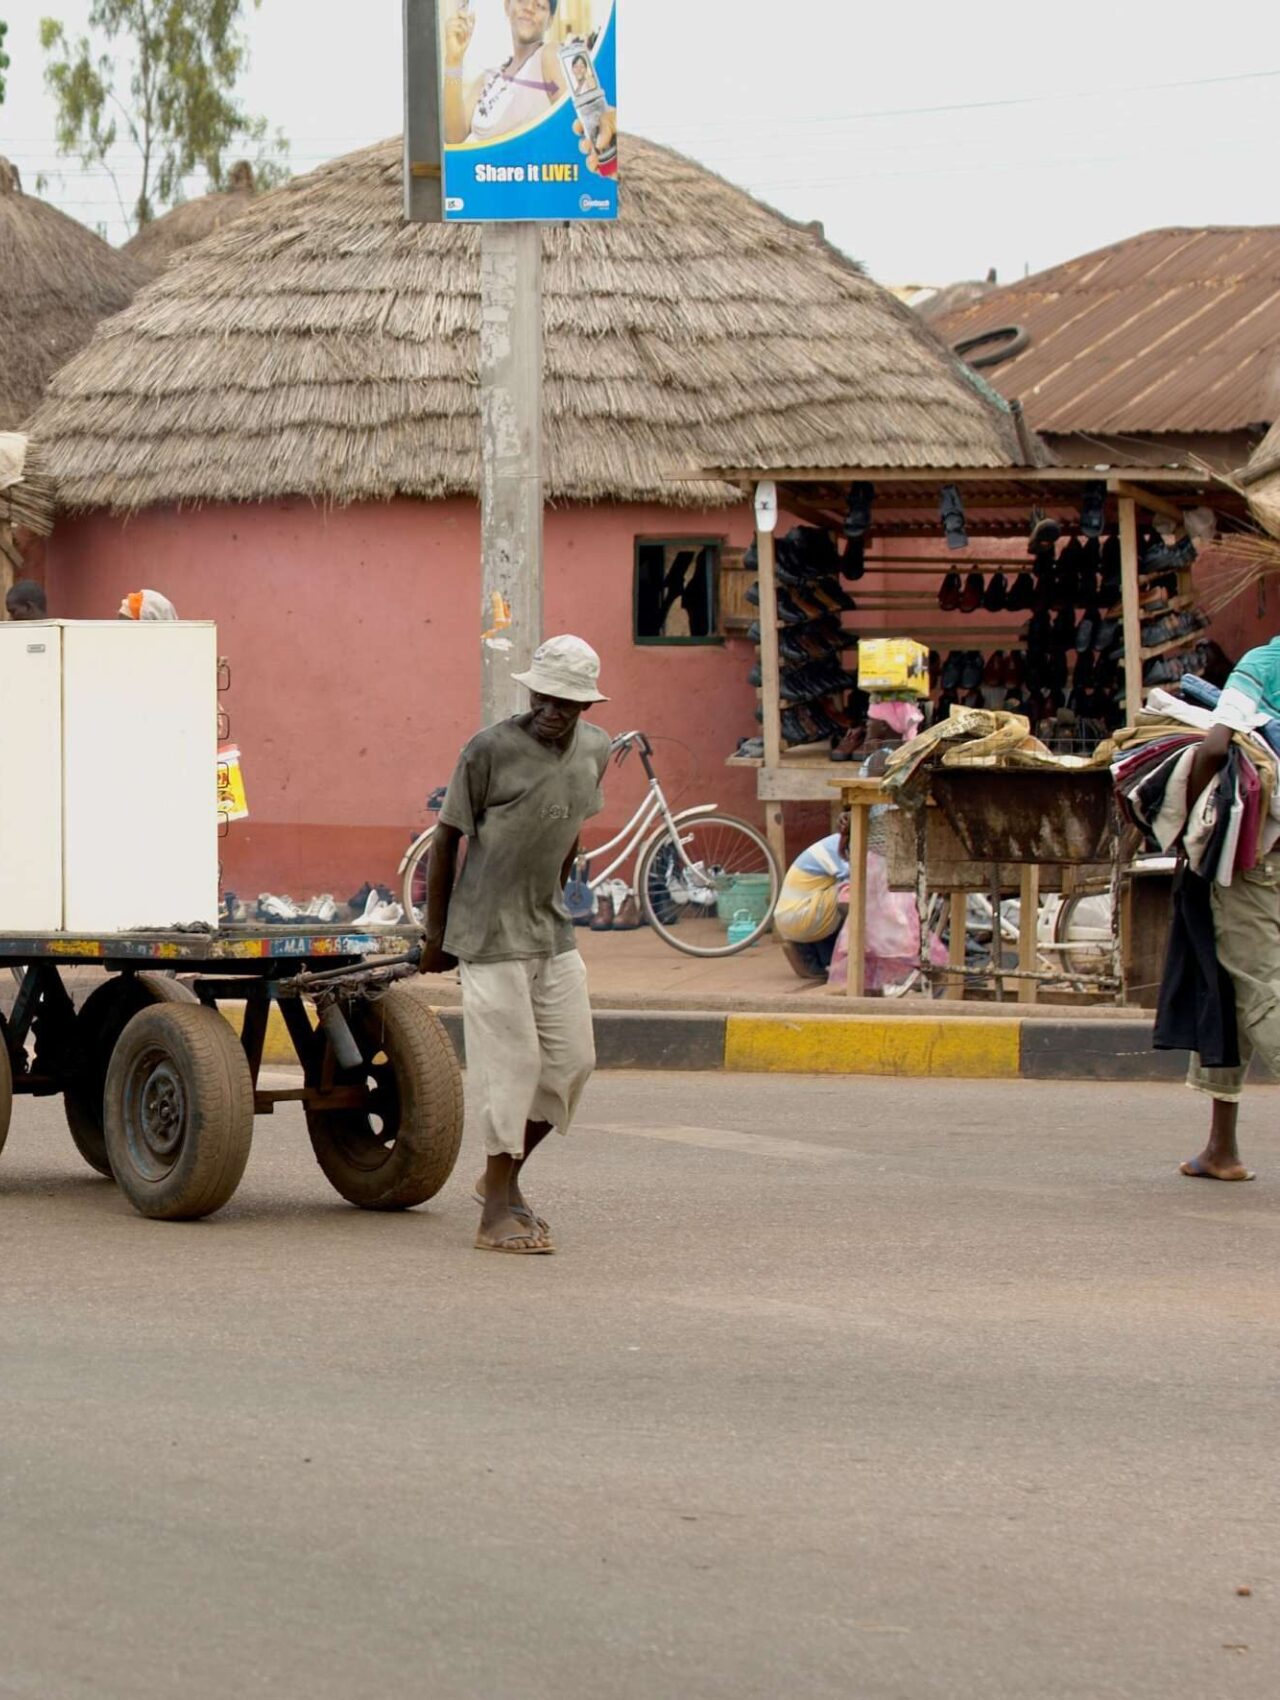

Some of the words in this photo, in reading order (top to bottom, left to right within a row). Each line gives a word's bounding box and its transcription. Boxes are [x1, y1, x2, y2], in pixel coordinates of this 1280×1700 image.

[474, 163, 525, 182] Share
[527, 163, 539, 182] it
[542, 163, 579, 182] LIVE!
